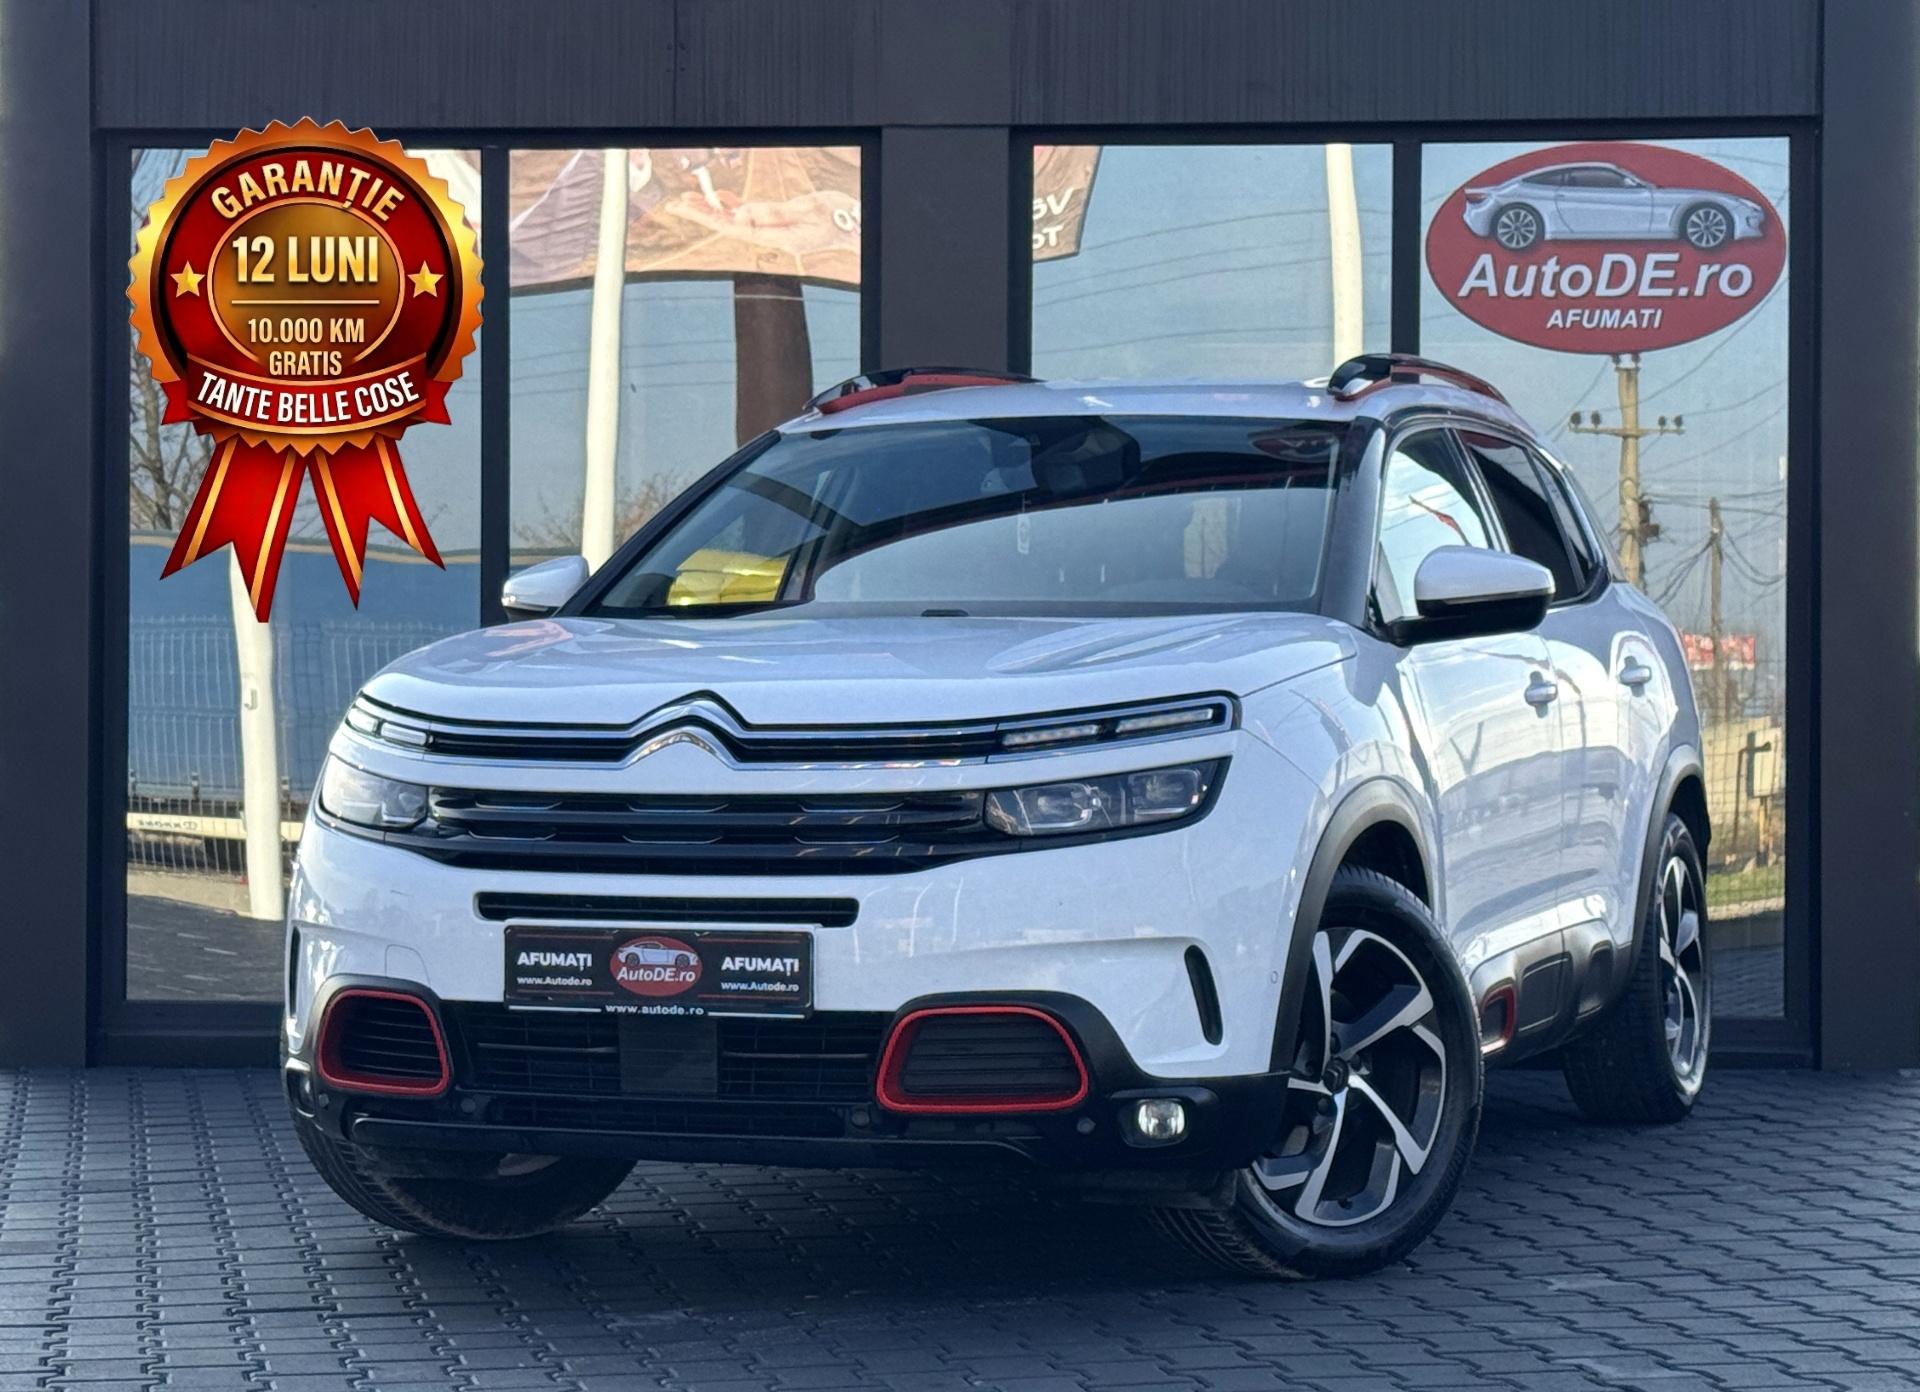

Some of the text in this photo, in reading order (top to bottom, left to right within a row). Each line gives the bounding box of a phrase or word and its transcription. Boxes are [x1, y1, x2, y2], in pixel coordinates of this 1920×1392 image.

[1457, 252, 1754, 299] AutoDE.ro
[1545, 307, 1663, 330] AFUMATI
[516, 951, 593, 972] AFUMAȚI
[720, 956, 800, 977] AFUMAȚI
[516, 976, 593, 987] www.Autode.ro
[616, 966, 697, 983] AutoDE.ro
[720, 982, 800, 993] www.Autode.ro
[605, 1004, 705, 1016] www.autode.ro
